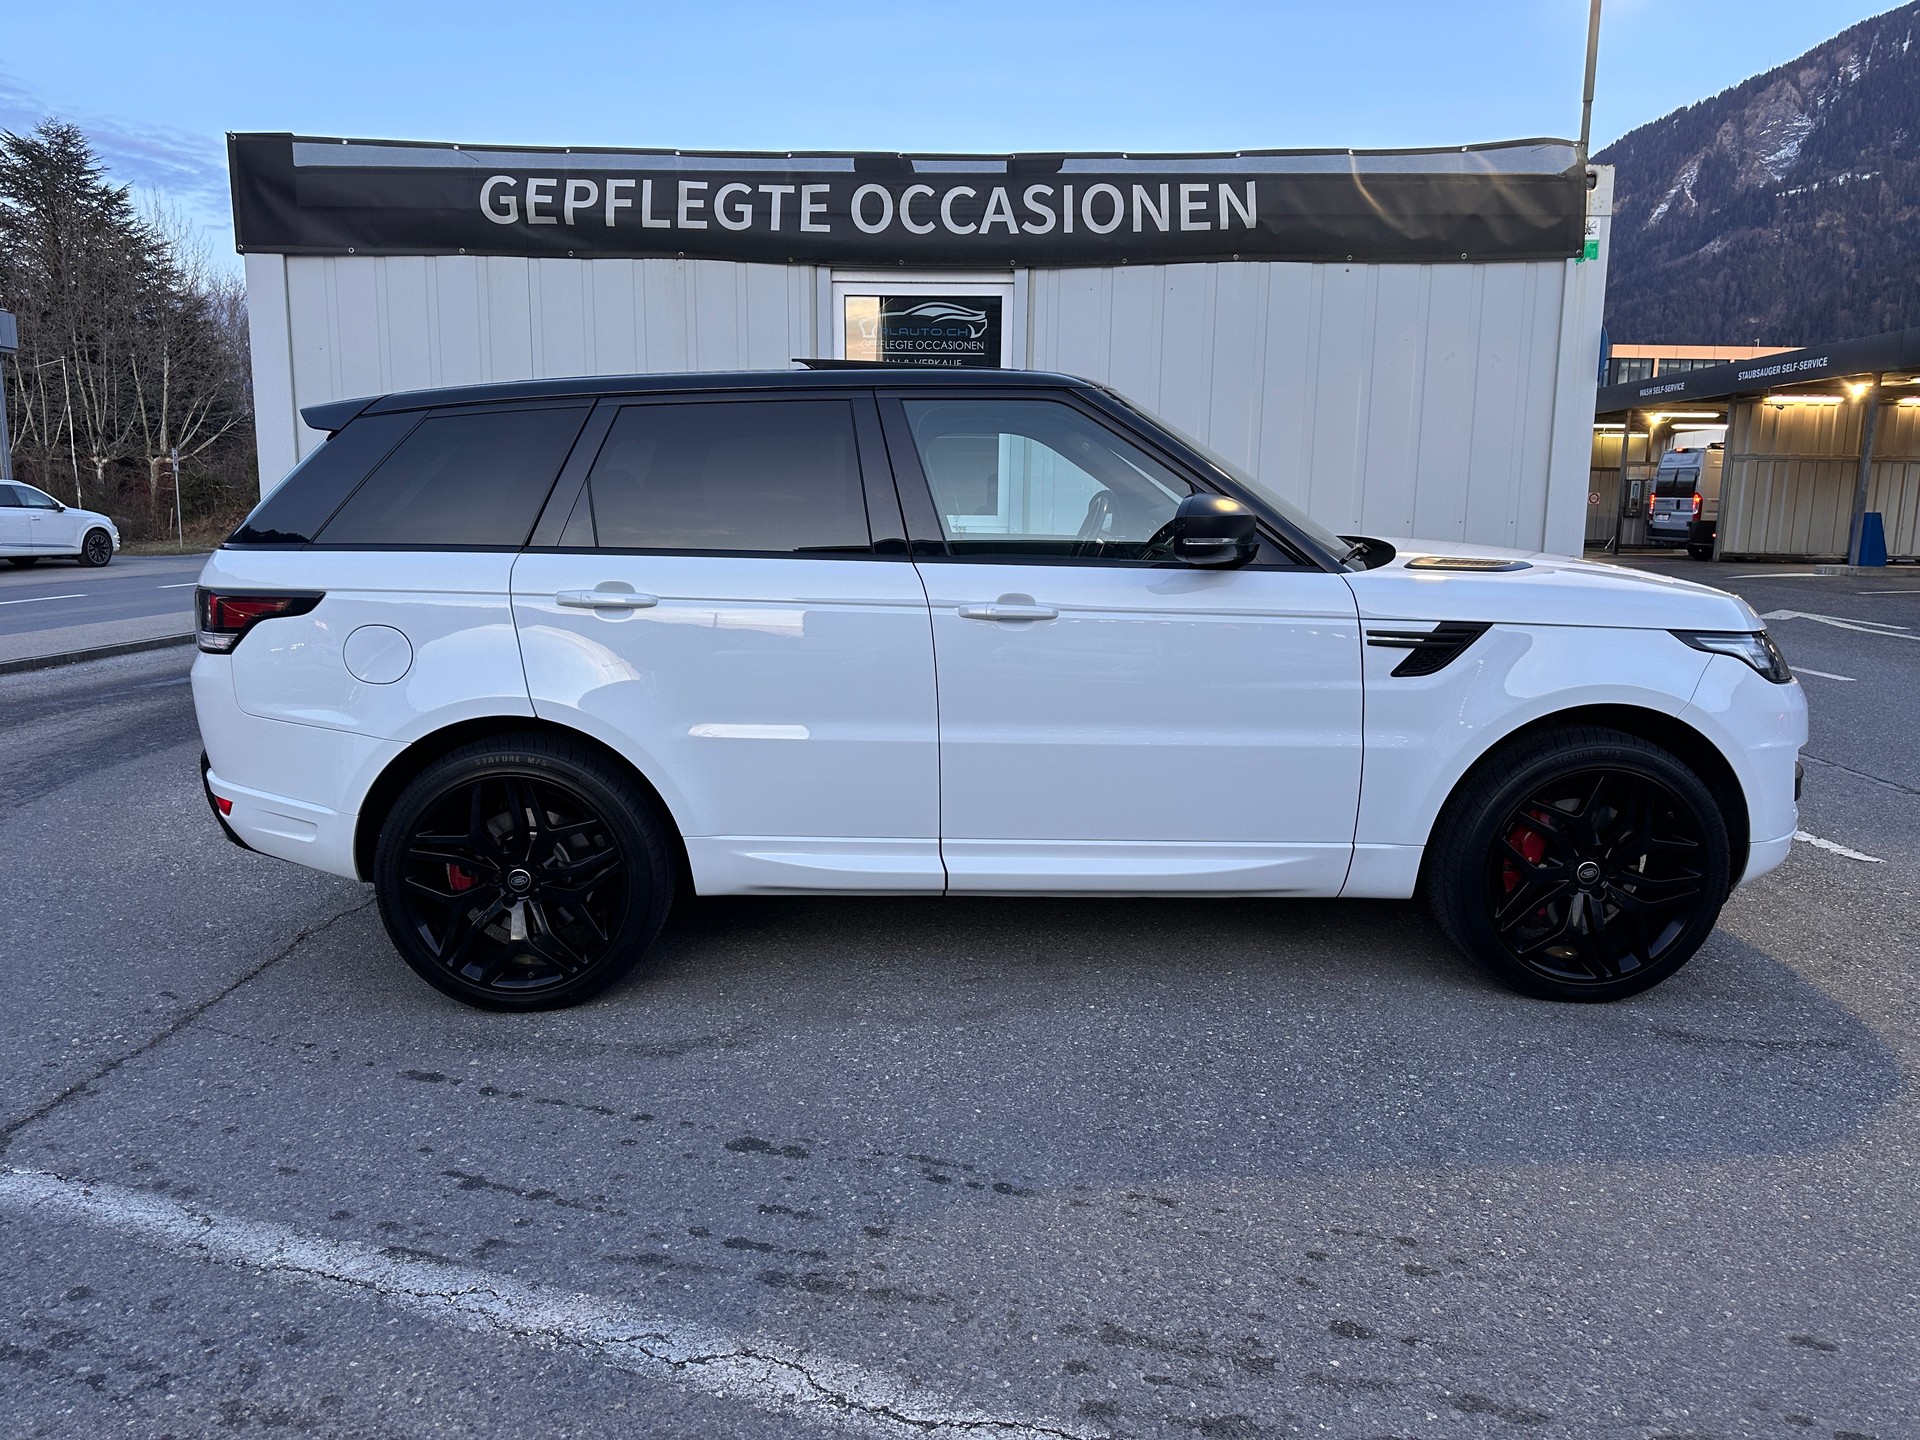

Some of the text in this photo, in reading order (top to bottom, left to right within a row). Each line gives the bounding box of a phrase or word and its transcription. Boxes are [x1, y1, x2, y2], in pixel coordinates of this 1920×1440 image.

[479, 175, 1258, 236] GEPFLEGTE OCCASIONEN
[915, 340, 985, 351] OCCASIONEN
[1737, 356, 1828, 381] STAUBSAUGER SELF-SERVICE
[1639, 382, 1685, 397] WASH SELF-SERVICE
[474, 754, 549, 767] STATURE M/S
